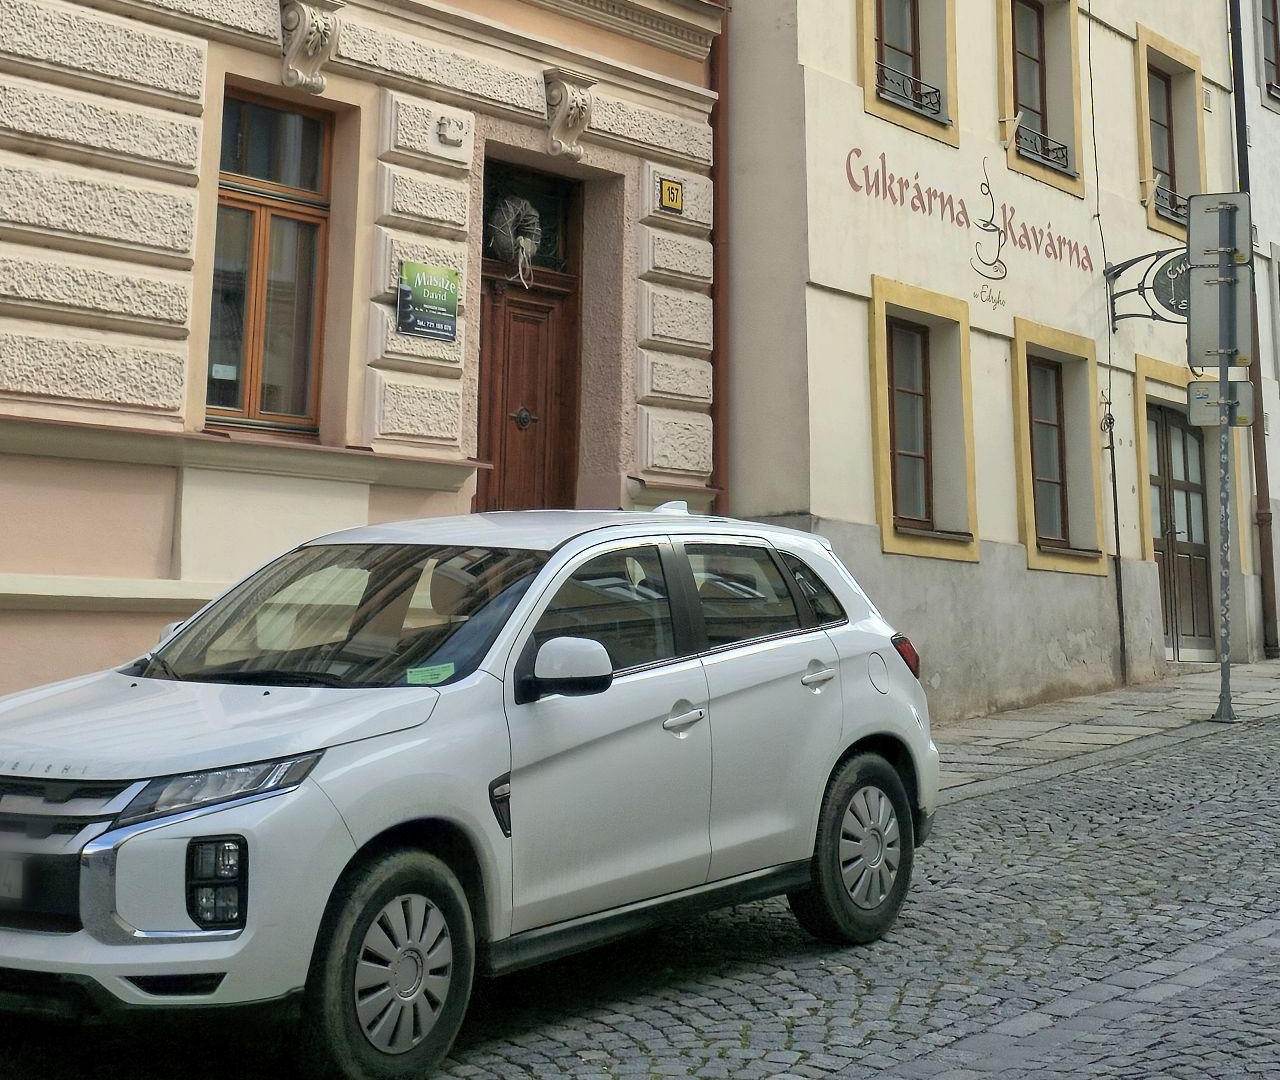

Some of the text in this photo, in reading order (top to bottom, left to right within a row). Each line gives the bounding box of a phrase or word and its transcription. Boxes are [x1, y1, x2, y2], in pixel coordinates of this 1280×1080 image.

[667, 186, 679, 203] 157
[845, 147, 1094, 272] Cukrárna Kavárna
[423, 288, 447, 301] David
